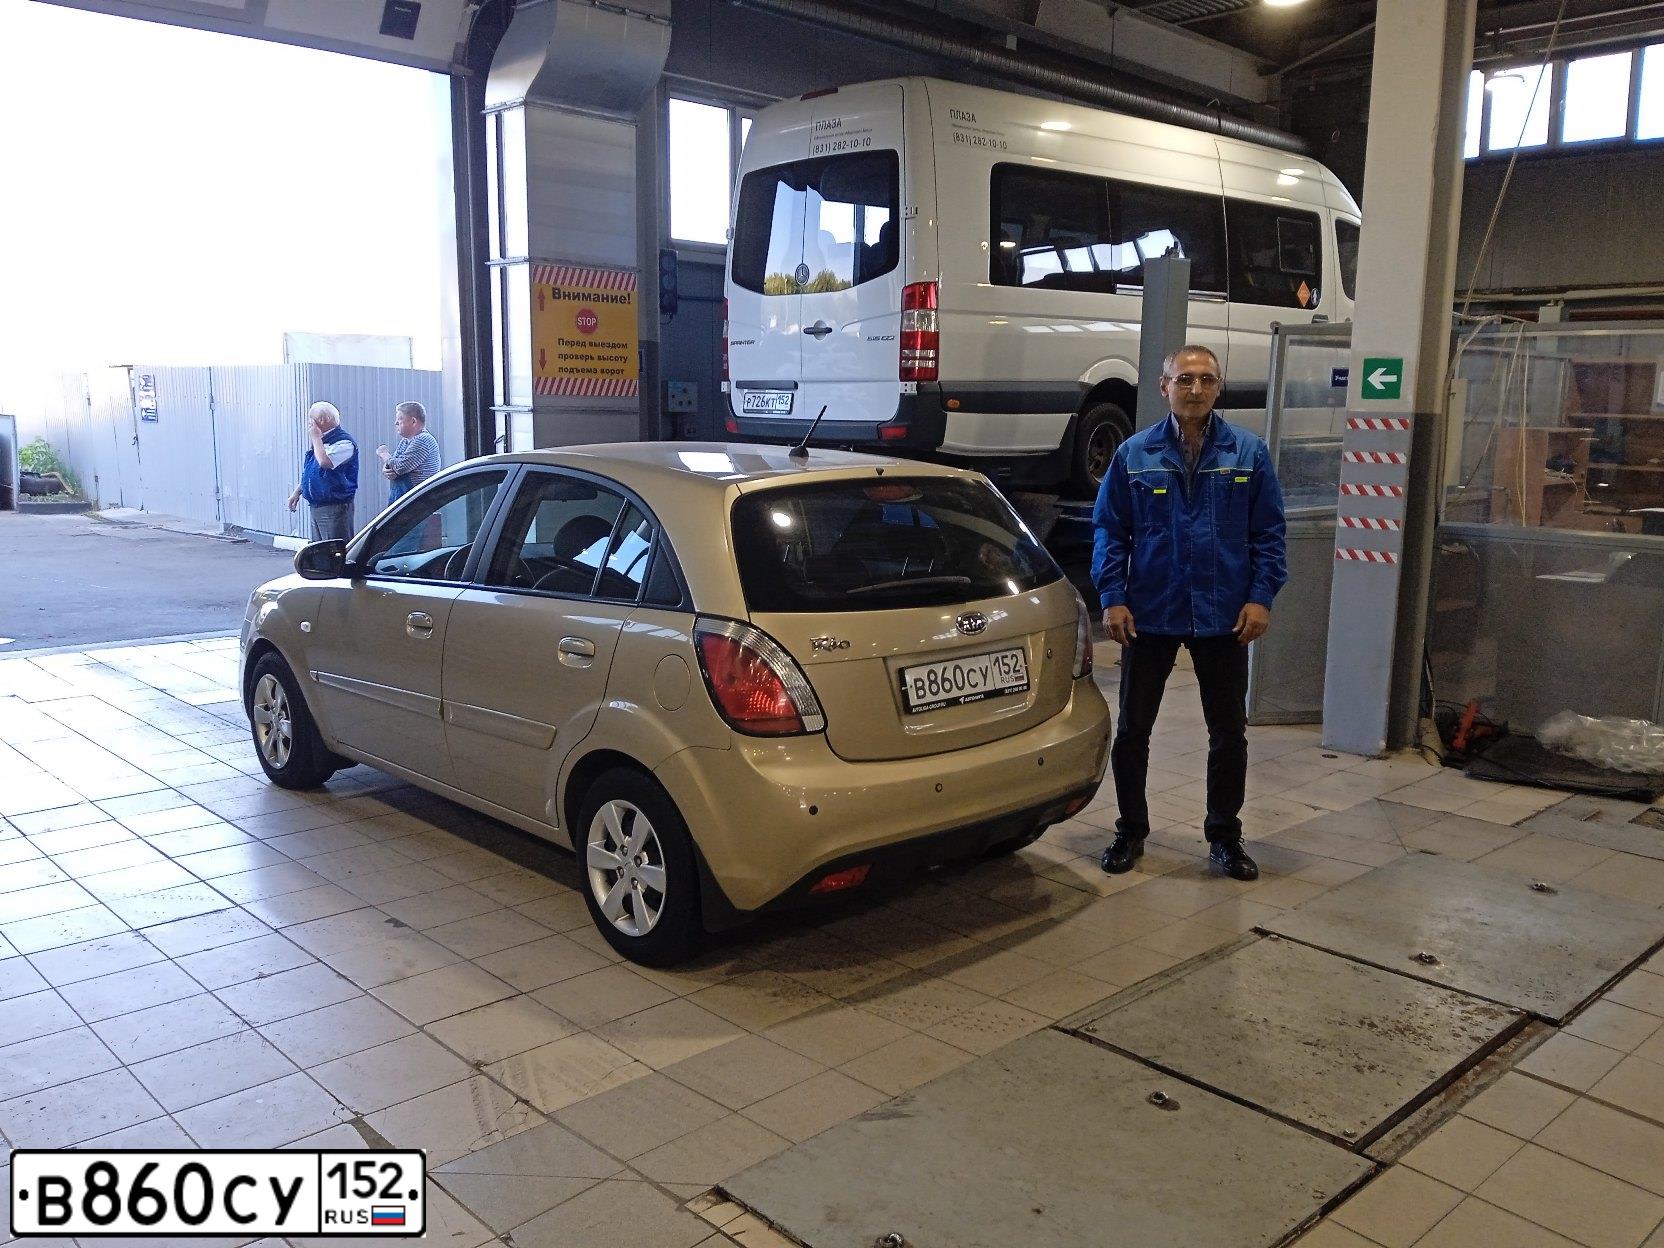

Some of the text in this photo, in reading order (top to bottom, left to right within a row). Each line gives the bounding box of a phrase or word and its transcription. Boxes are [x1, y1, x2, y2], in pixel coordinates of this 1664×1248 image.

[950, 108, 977, 123] ПЛАЗА
[815, 117, 842, 131] ПЛАЗА
[952, 131, 972, 146] (831)
[812, 136, 871, 156] (831) 282-10-10
[551, 287, 631, 304] Внимание!
[577, 316, 597, 326] STOP
[557, 338, 628, 350] Перед выездом
[558, 353, 628, 363] проверь высоту
[558, 366, 625, 376] подъема ворот
[777, 394, 790, 405] 152
[810, 636, 851, 652] Rio
[913, 653, 1021, 700] В860СУ 152
[1000, 674, 1015, 684] RUS
